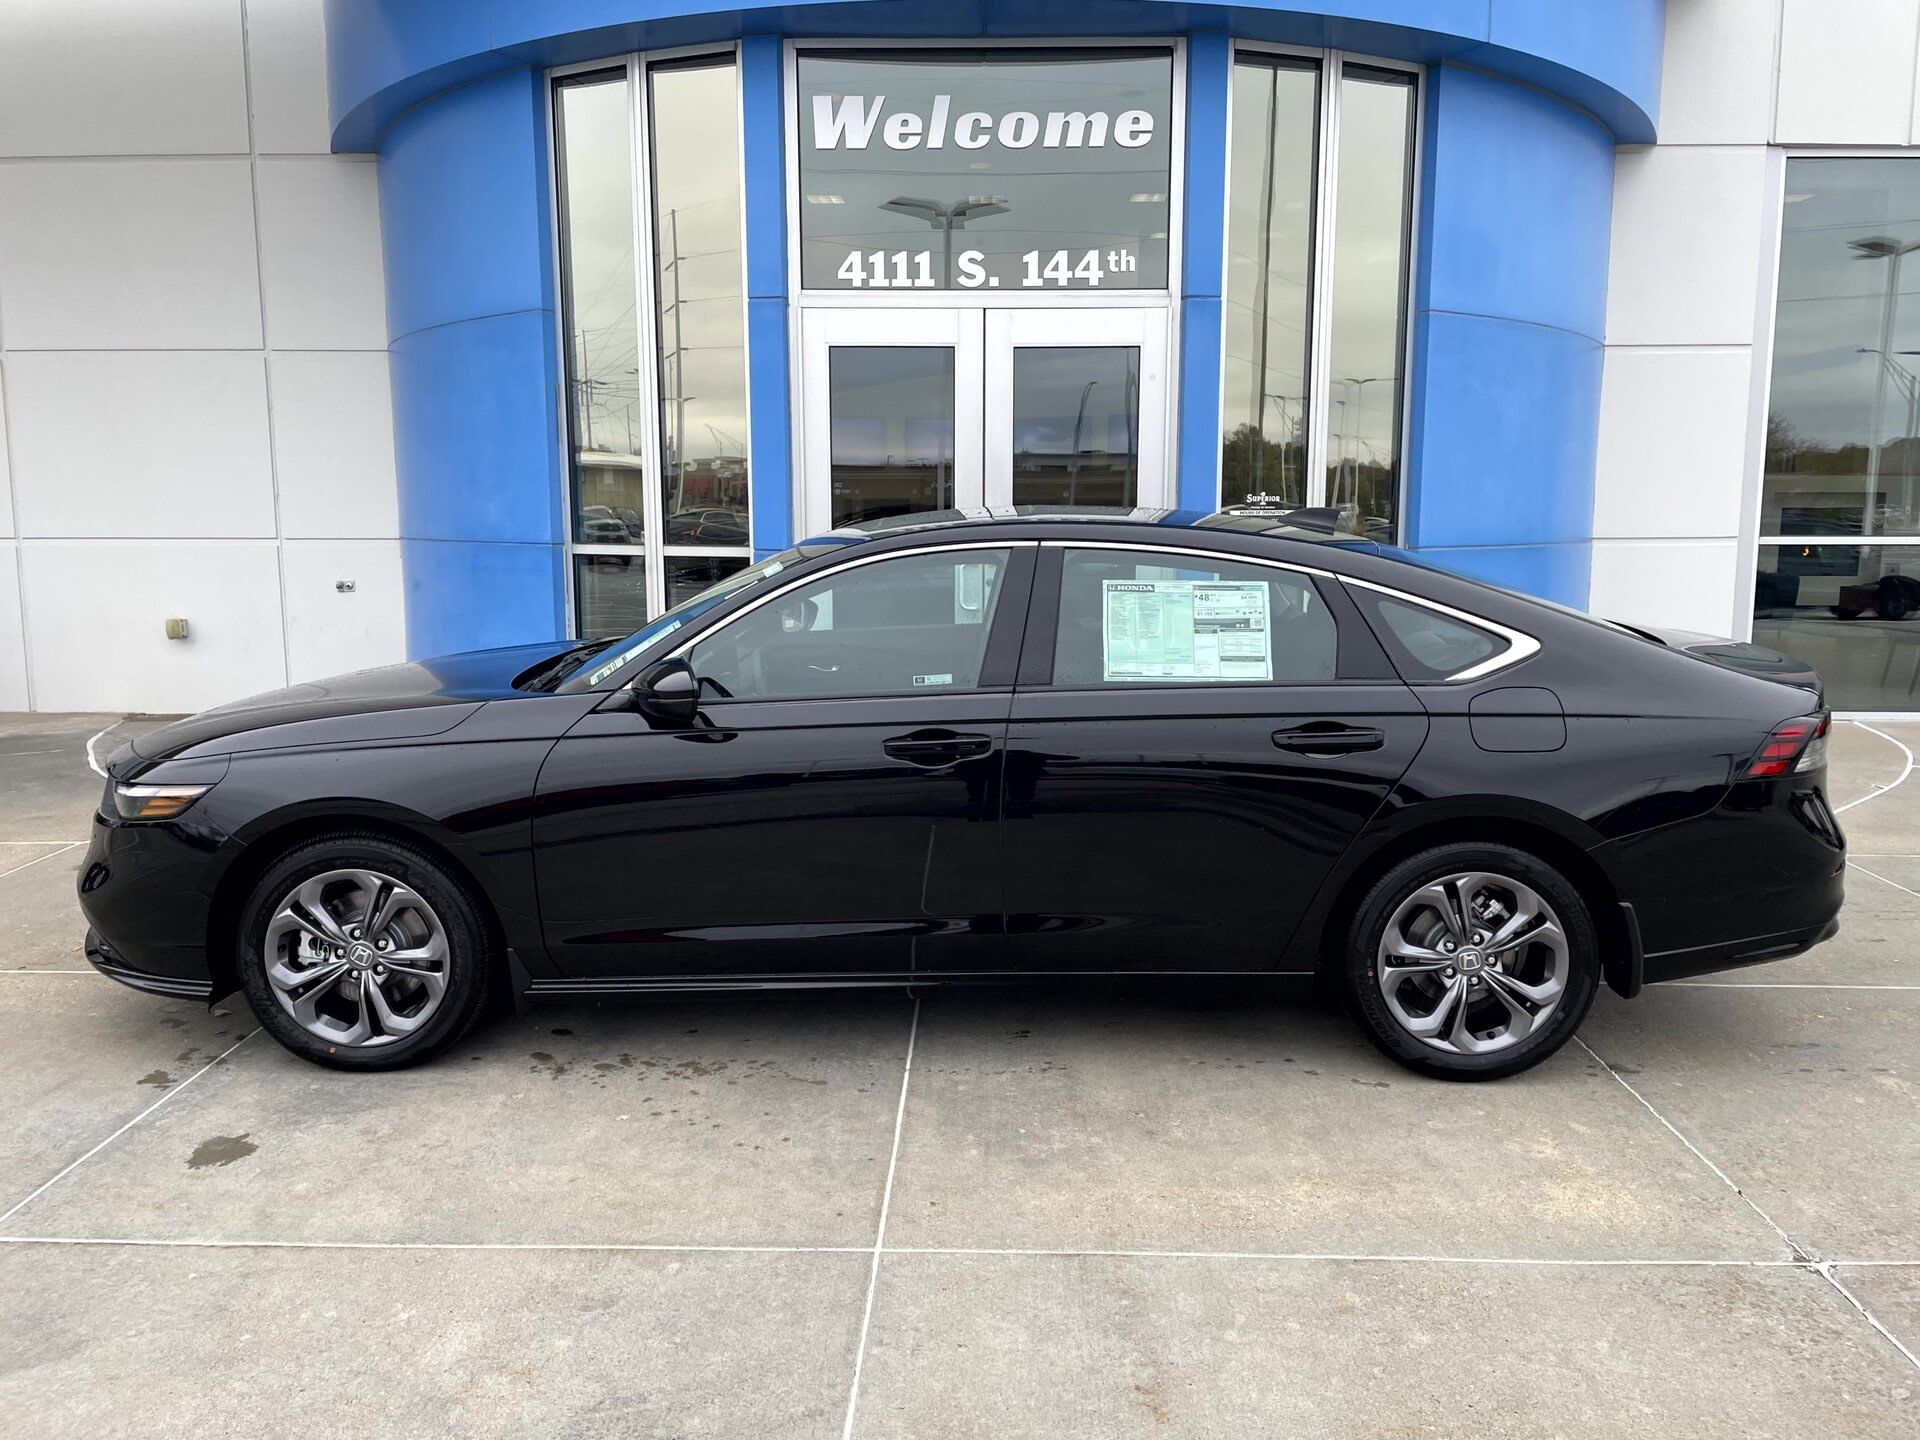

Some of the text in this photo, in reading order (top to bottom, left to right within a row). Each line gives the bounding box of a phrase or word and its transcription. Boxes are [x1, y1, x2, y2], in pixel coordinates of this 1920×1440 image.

[812, 95, 1155, 150] Welcome
[837, 249, 1137, 288] 4111 S. 144th
[1198, 593, 1210, 602] 48
